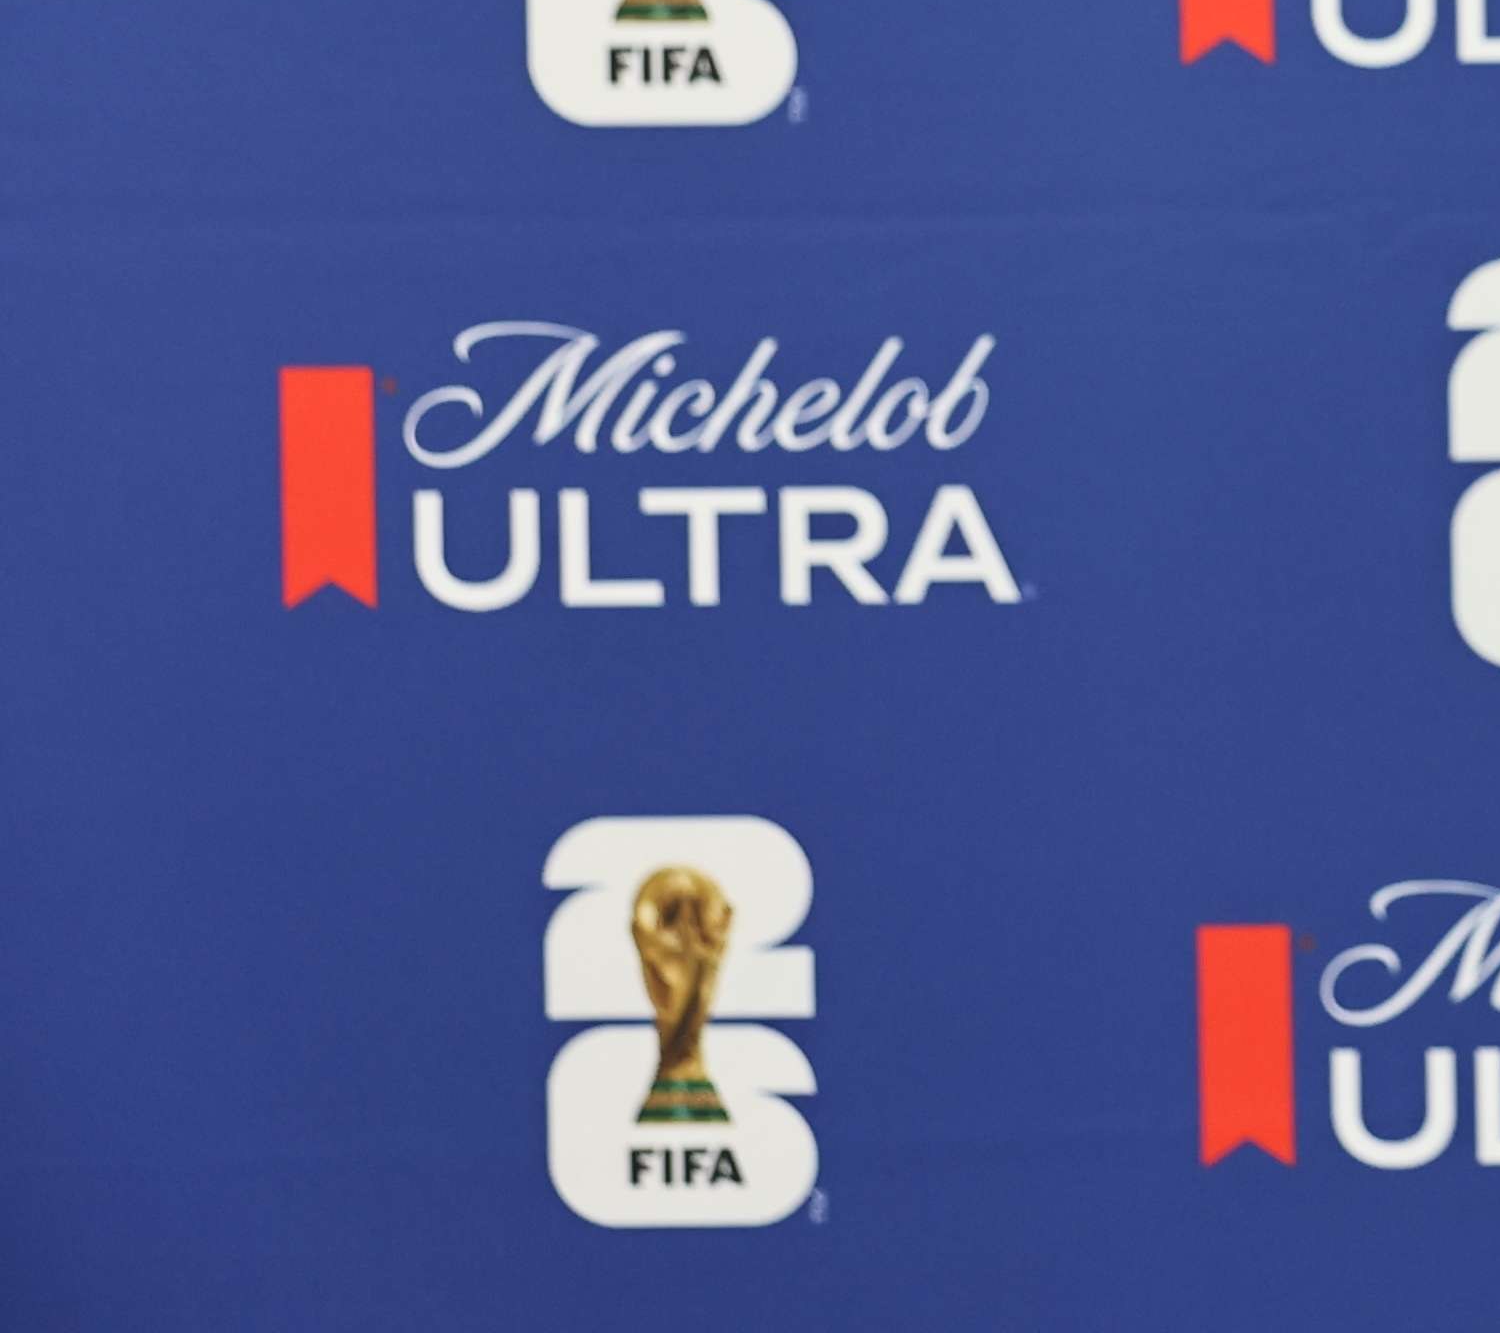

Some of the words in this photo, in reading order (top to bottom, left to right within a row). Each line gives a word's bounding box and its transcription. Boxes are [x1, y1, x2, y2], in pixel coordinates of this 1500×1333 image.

[608, 45, 722, 85] FIFA
[402, 320, 996, 470] Michelob
[412, 483, 1023, 613] ULTRA
[628, 1147, 744, 1187] FIFA
